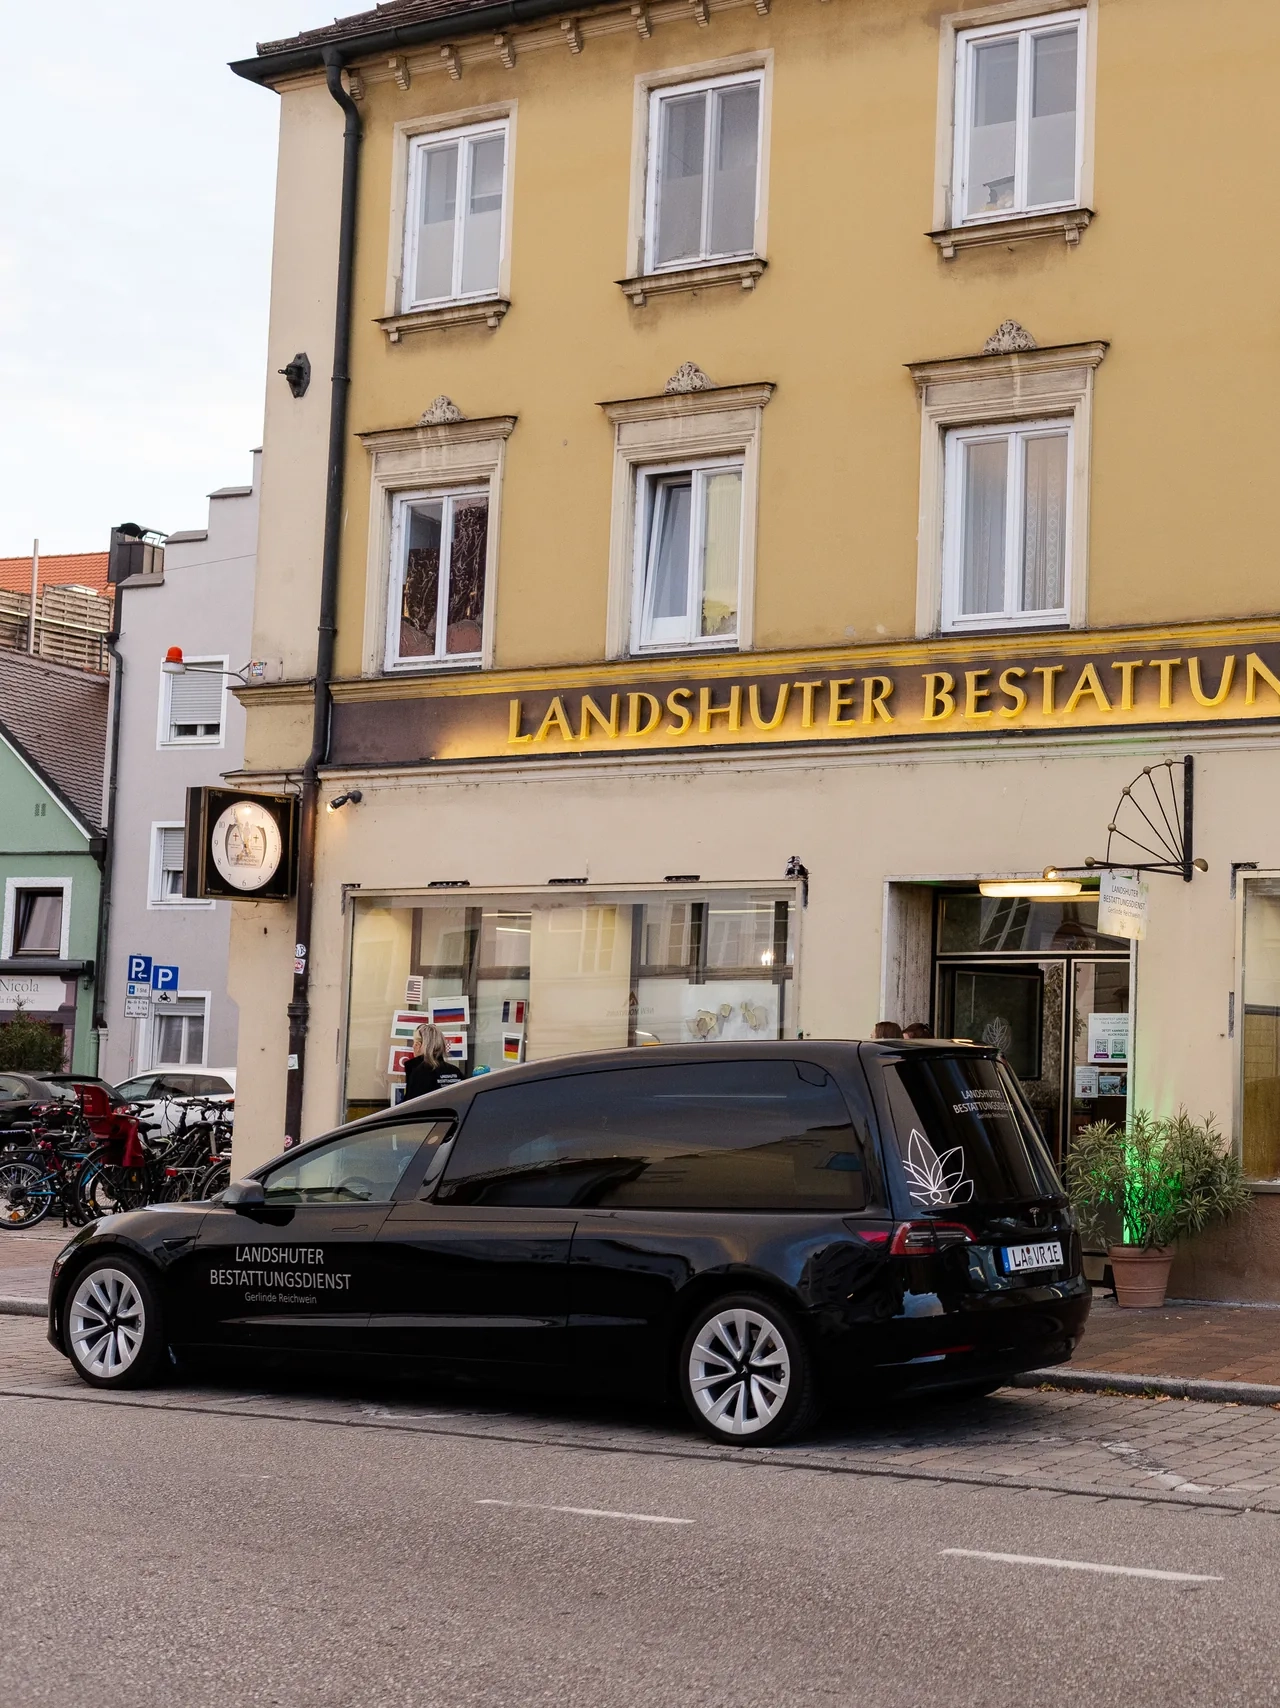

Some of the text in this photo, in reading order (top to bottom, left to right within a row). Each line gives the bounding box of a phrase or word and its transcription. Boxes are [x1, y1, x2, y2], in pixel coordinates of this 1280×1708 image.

[507, 675, 896, 744] LANDSHUTER
[131, 958, 146, 979] P
[158, 968, 173, 989] P
[0, 979, 39, 992] Nicola
[235, 1246, 324, 1265] LANDSHUTER
[1012, 1249, 1029, 1267] LA
[1032, 1246, 1048, 1265] VR
[210, 1269, 352, 1290] BESTATTUNGSDIENST
[244, 1292, 318, 1304] Gerlinde Reichwein
